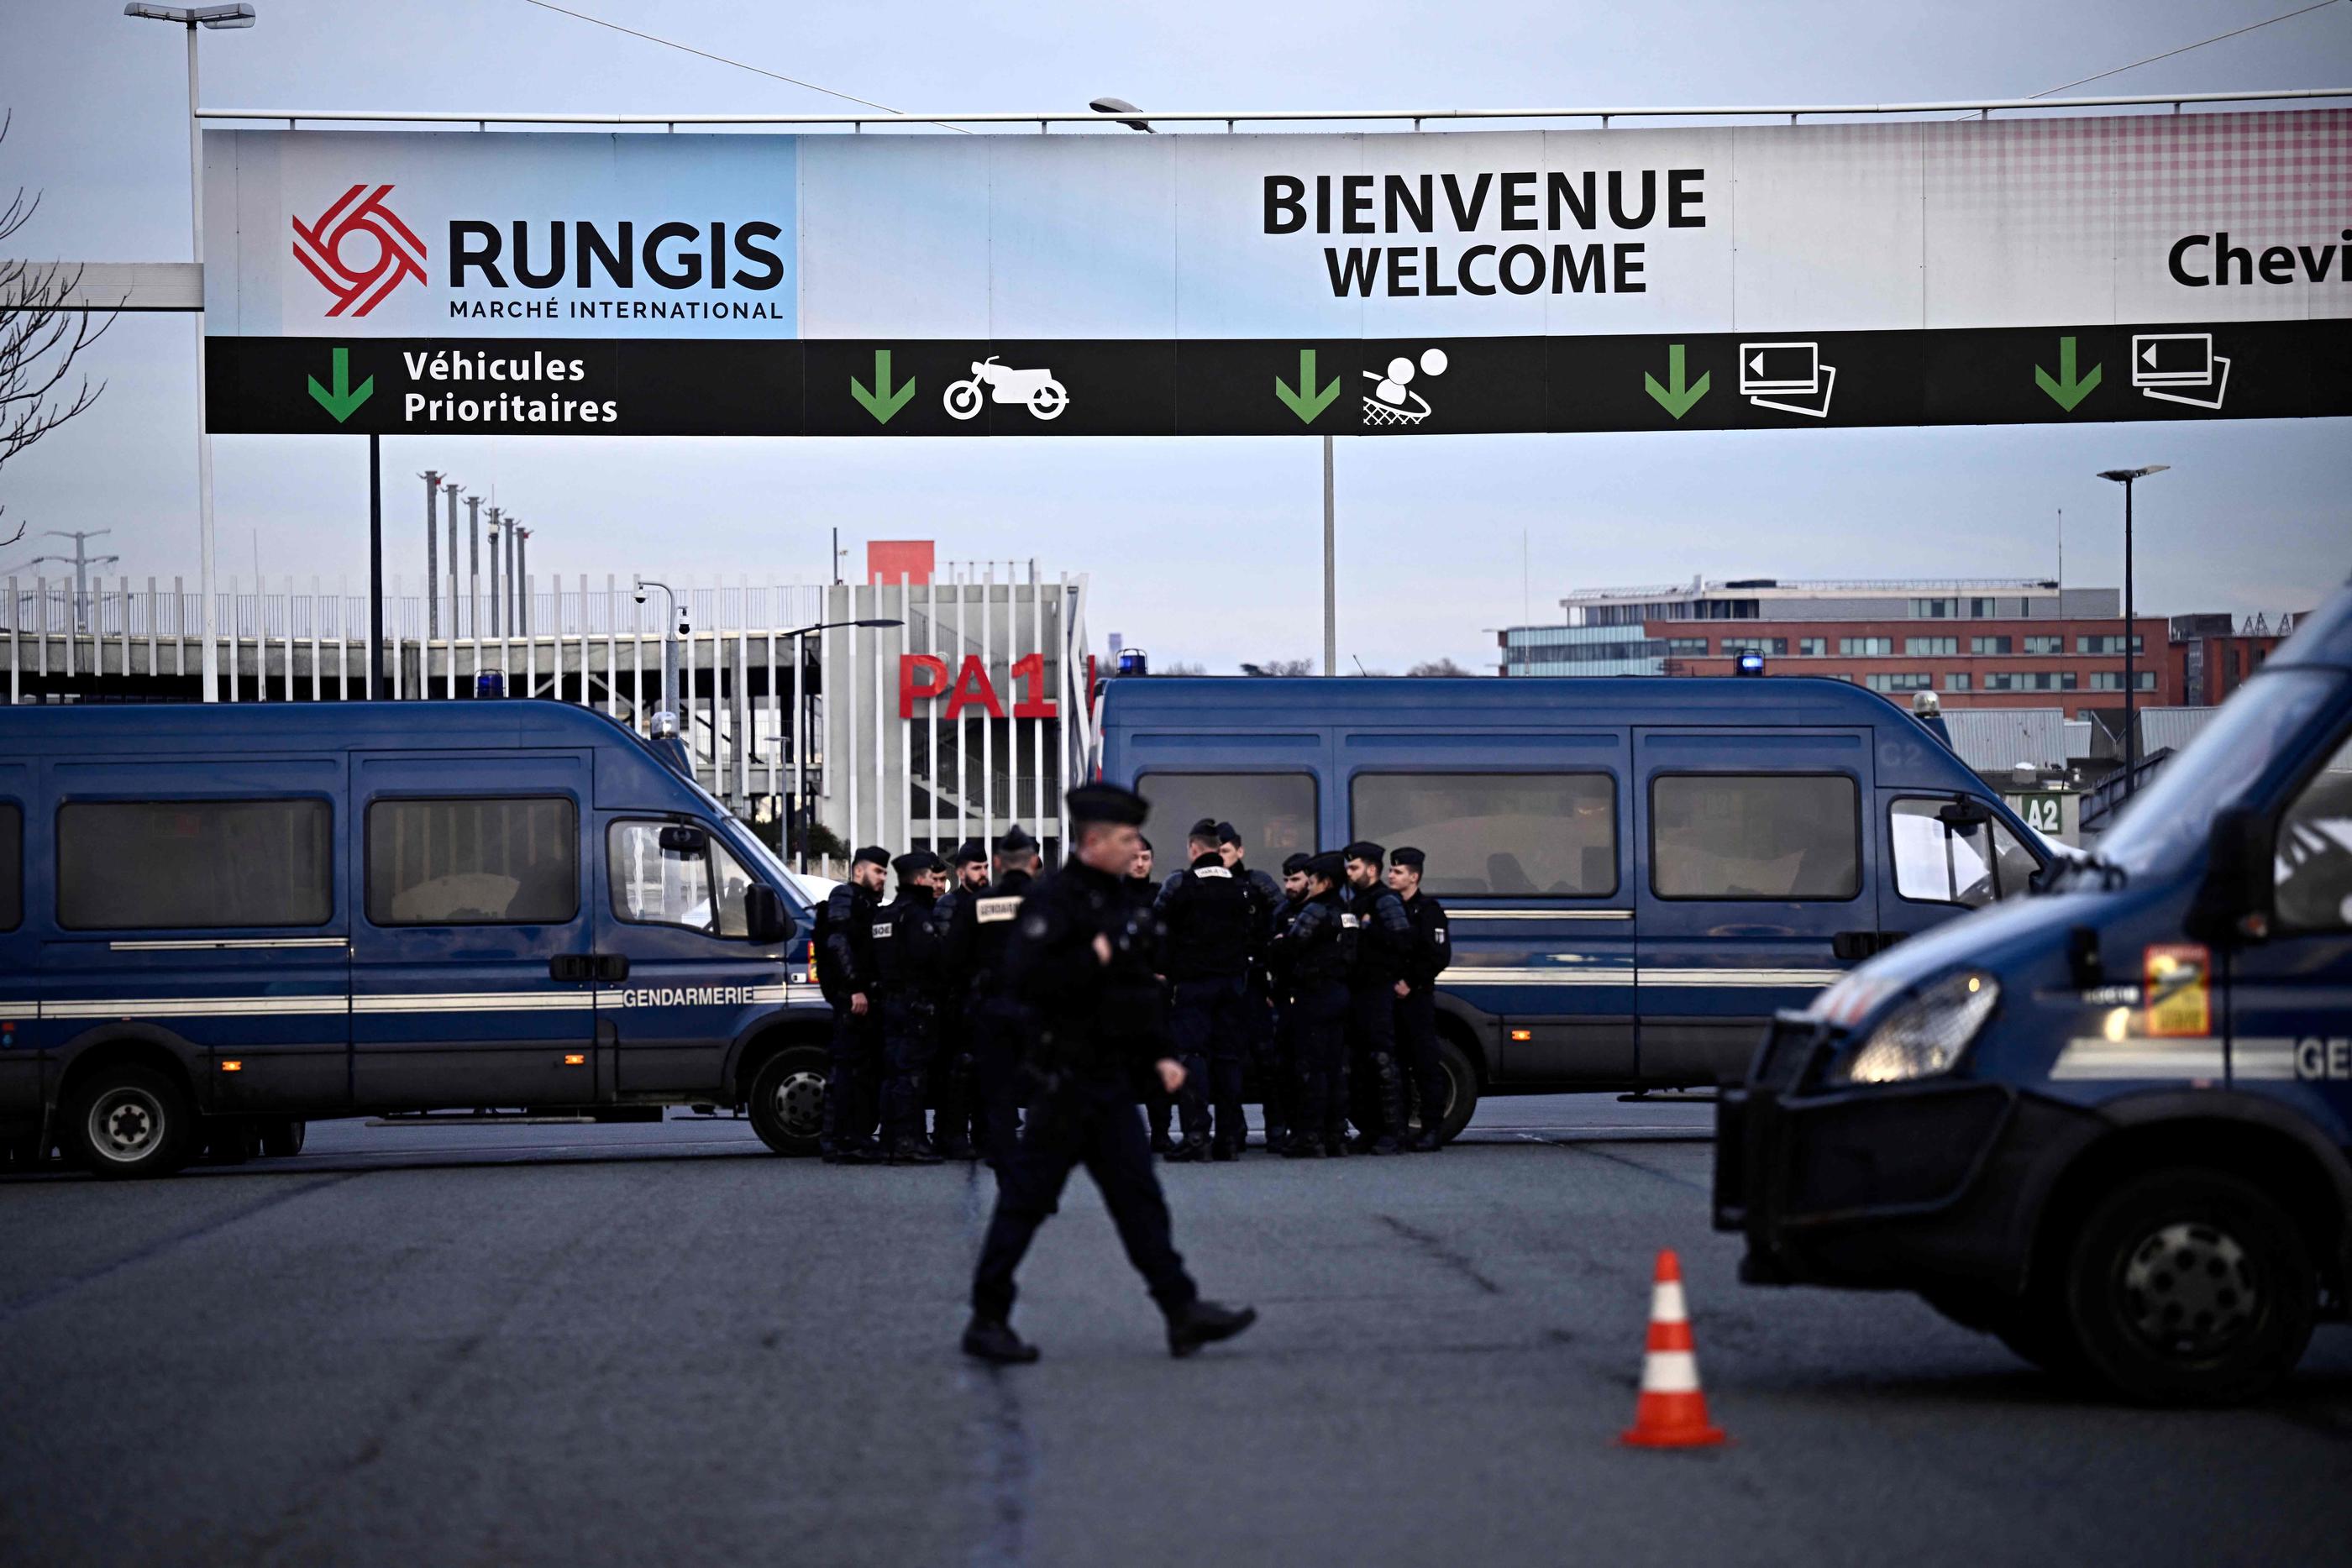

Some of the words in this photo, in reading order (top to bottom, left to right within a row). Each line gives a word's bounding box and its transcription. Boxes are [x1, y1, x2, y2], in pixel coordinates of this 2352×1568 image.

[1263, 169, 1706, 234] BIENVENUE
[449, 220, 785, 291] RUNGIS
[1323, 243, 1646, 297] WELCOME
[2168, 228, 2352, 287] Chevi
[451, 296, 559, 318] MARCHÉ
[570, 301, 784, 320] INTERNATIONAL
[403, 350, 585, 381] Véhicules
[405, 391, 617, 422] Prioritaires
[900, 653, 1057, 720] PA1
[2027, 800, 2058, 831] A2
[623, 987, 753, 1007] GENDARMERIE
[2297, 1037, 2349, 1078] GE
